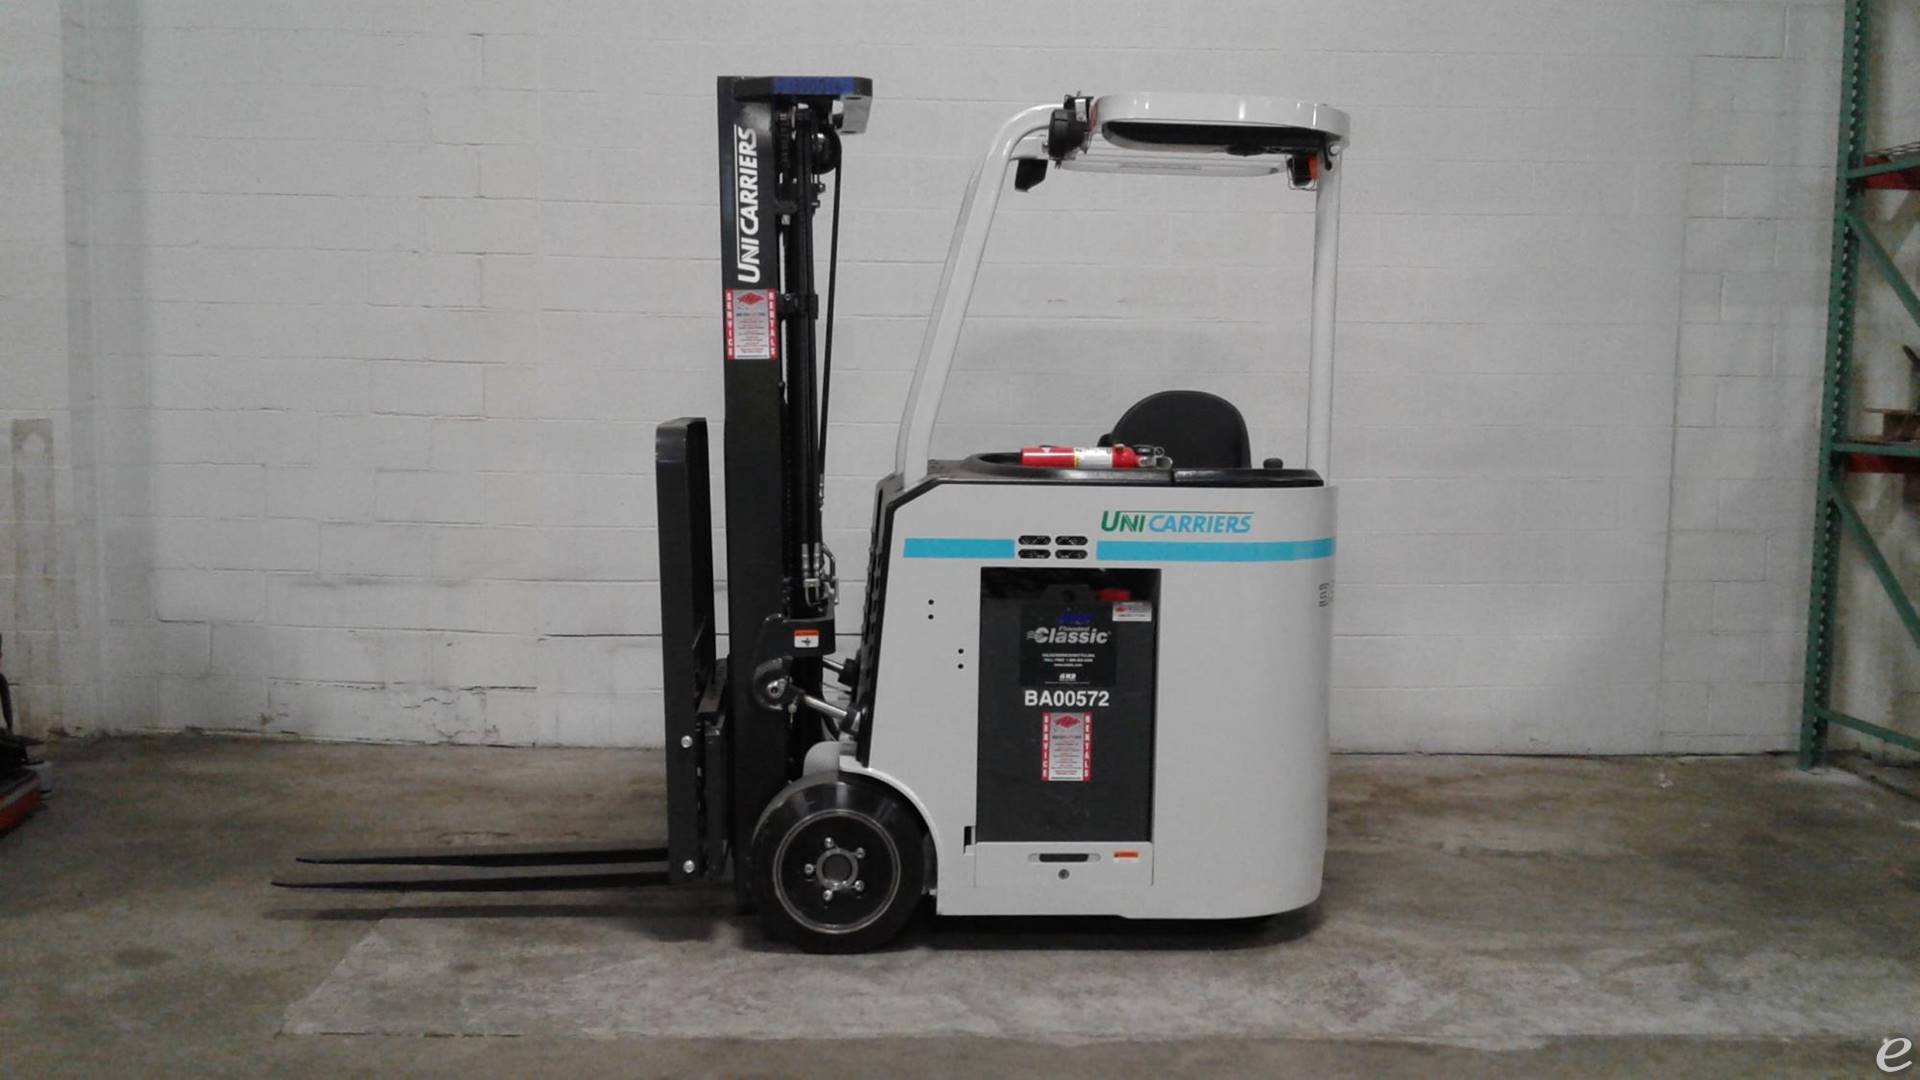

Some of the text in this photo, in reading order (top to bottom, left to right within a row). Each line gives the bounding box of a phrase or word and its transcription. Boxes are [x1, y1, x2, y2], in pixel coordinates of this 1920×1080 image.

[737, 126, 761, 284] UNICARRIERS
[1034, 627, 1109, 644] Classic
[1024, 690, 1110, 706] BA00572
